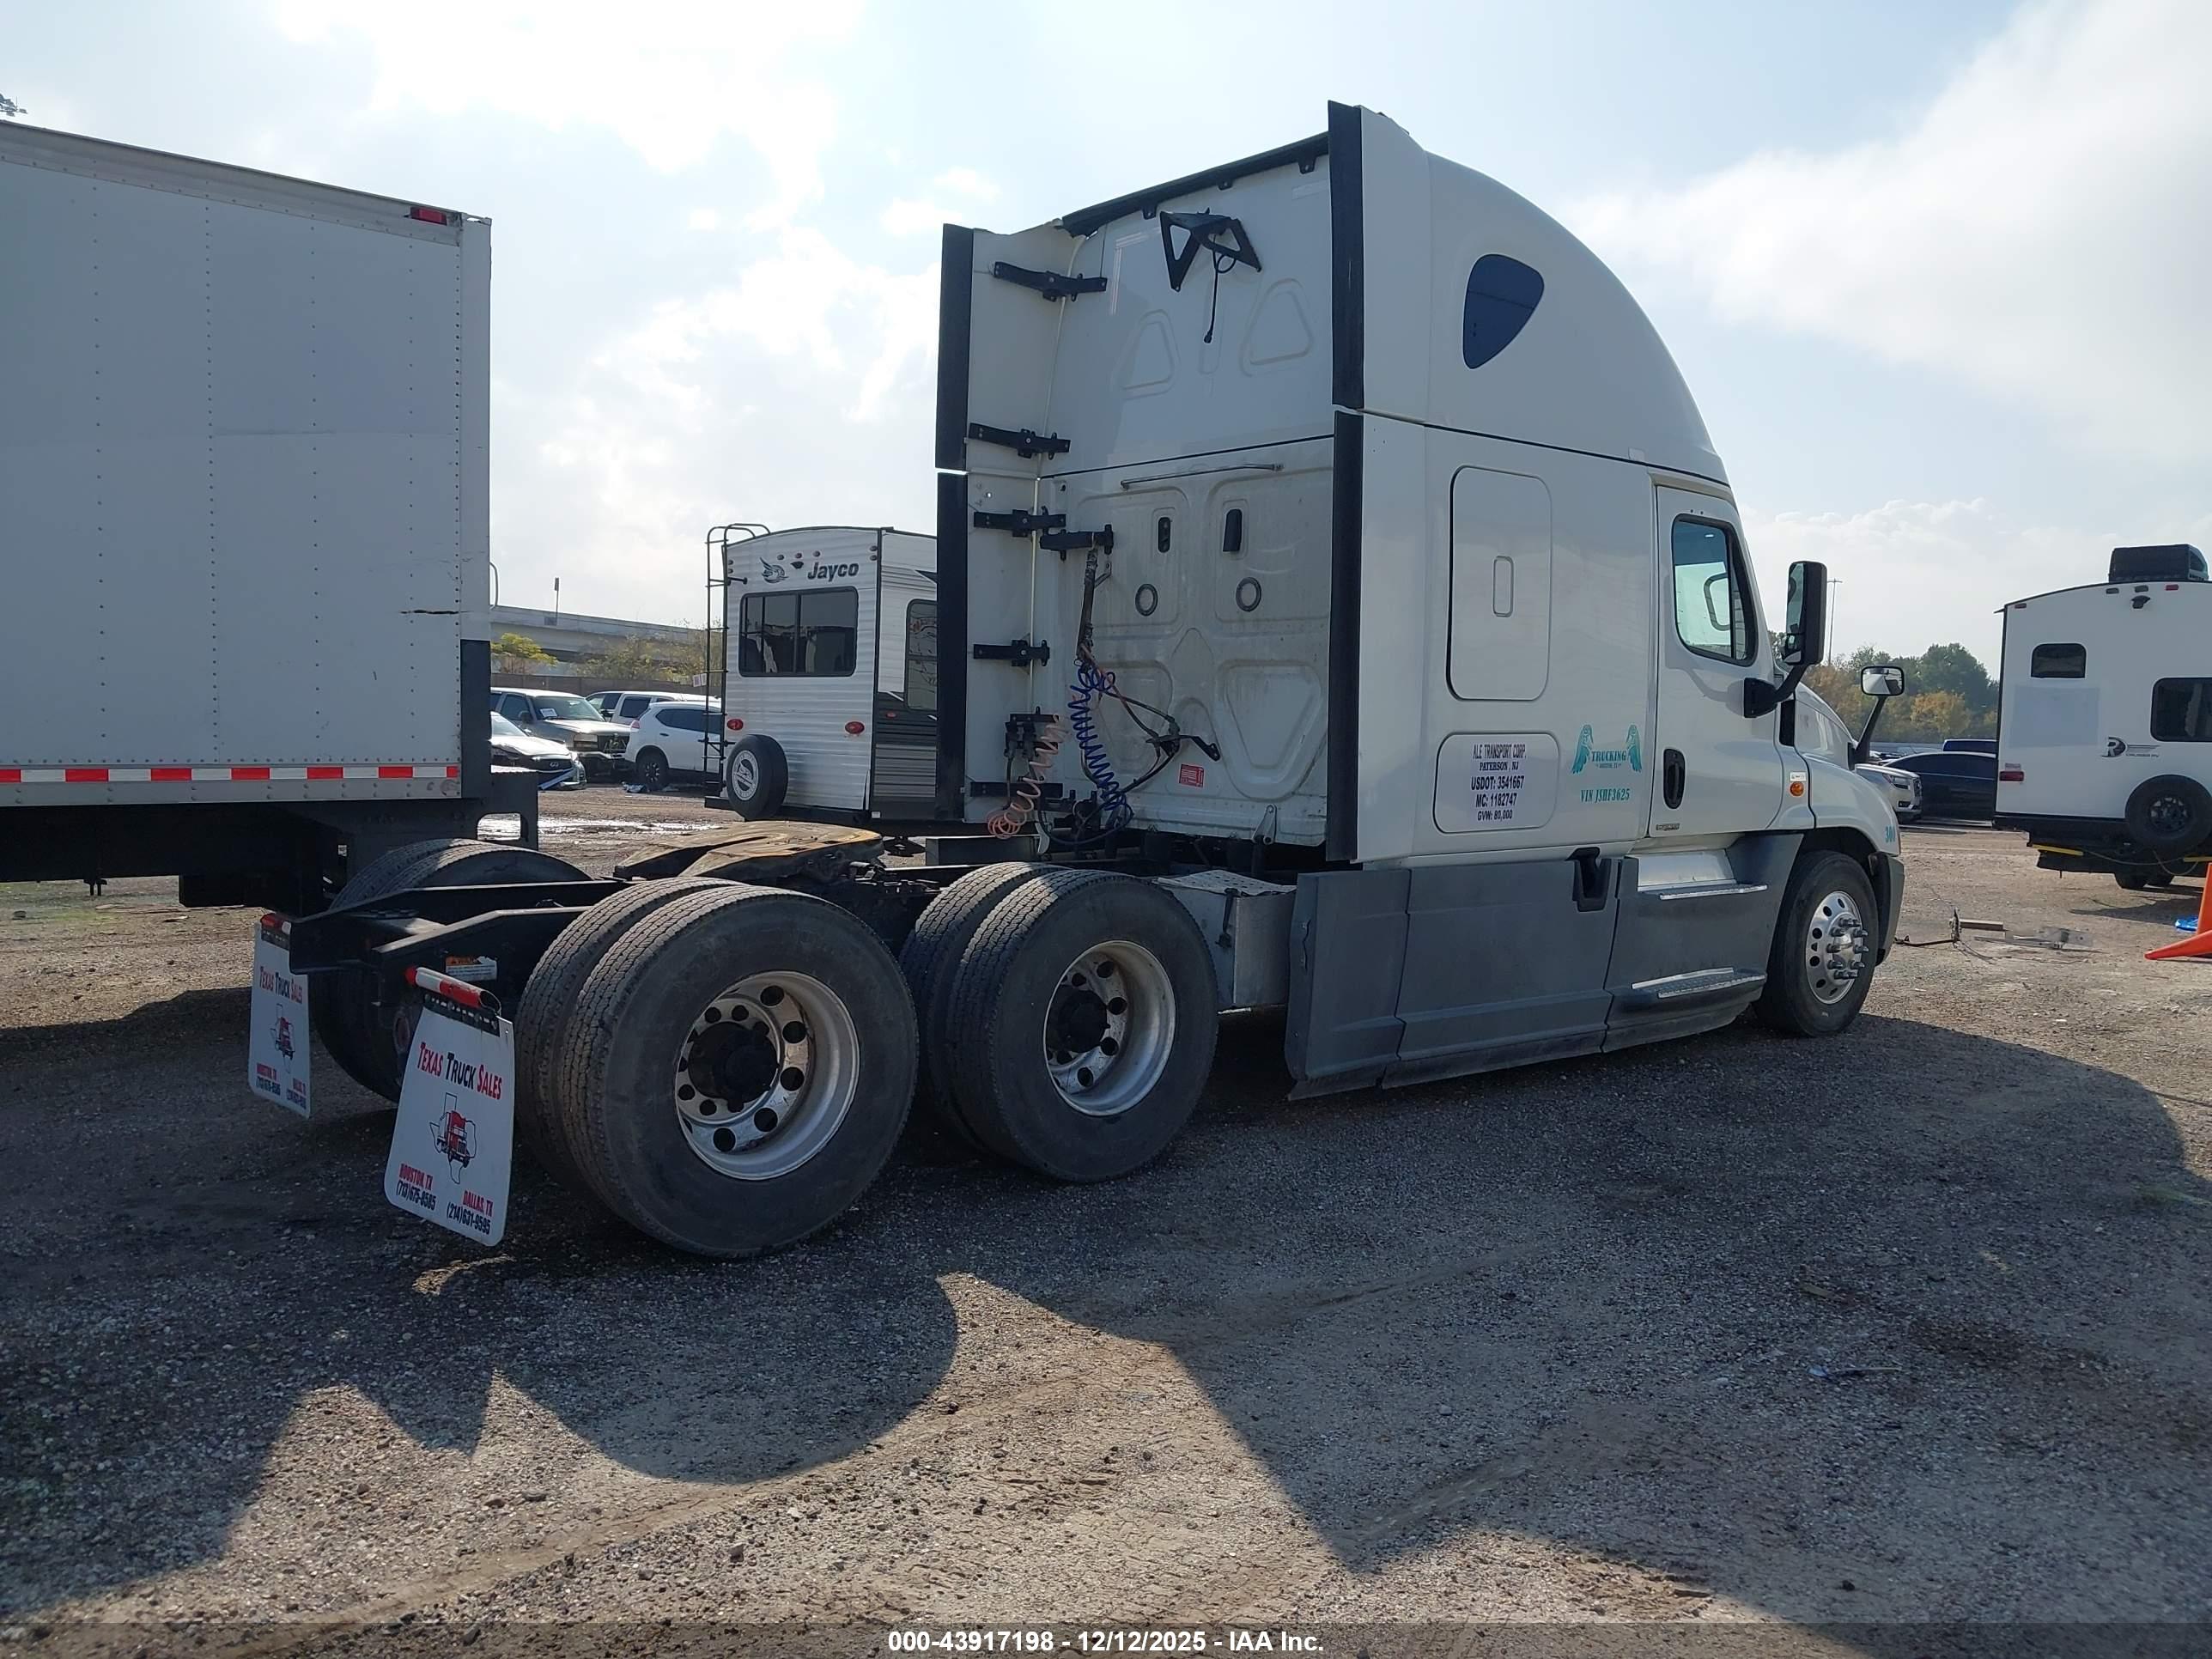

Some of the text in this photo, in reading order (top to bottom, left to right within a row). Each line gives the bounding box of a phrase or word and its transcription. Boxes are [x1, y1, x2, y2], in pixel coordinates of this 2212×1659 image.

[808, 562, 860, 582] Jayco
[1484, 744, 1512, 759] TRANSPORT
[1591, 750, 1626, 763] TRUCKING
[1471, 775, 1525, 791] USDOT: 3541667
[1475, 793, 1517, 808] MC: 1182747
[1581, 789, 1594, 803] VIN
[1477, 810, 1493, 821] GVW:
[259, 966, 274, 992] TEXAS
[275, 971, 290, 1000] TRUCK
[417, 1042, 502, 1101] TEXAS TRUCK SALES
